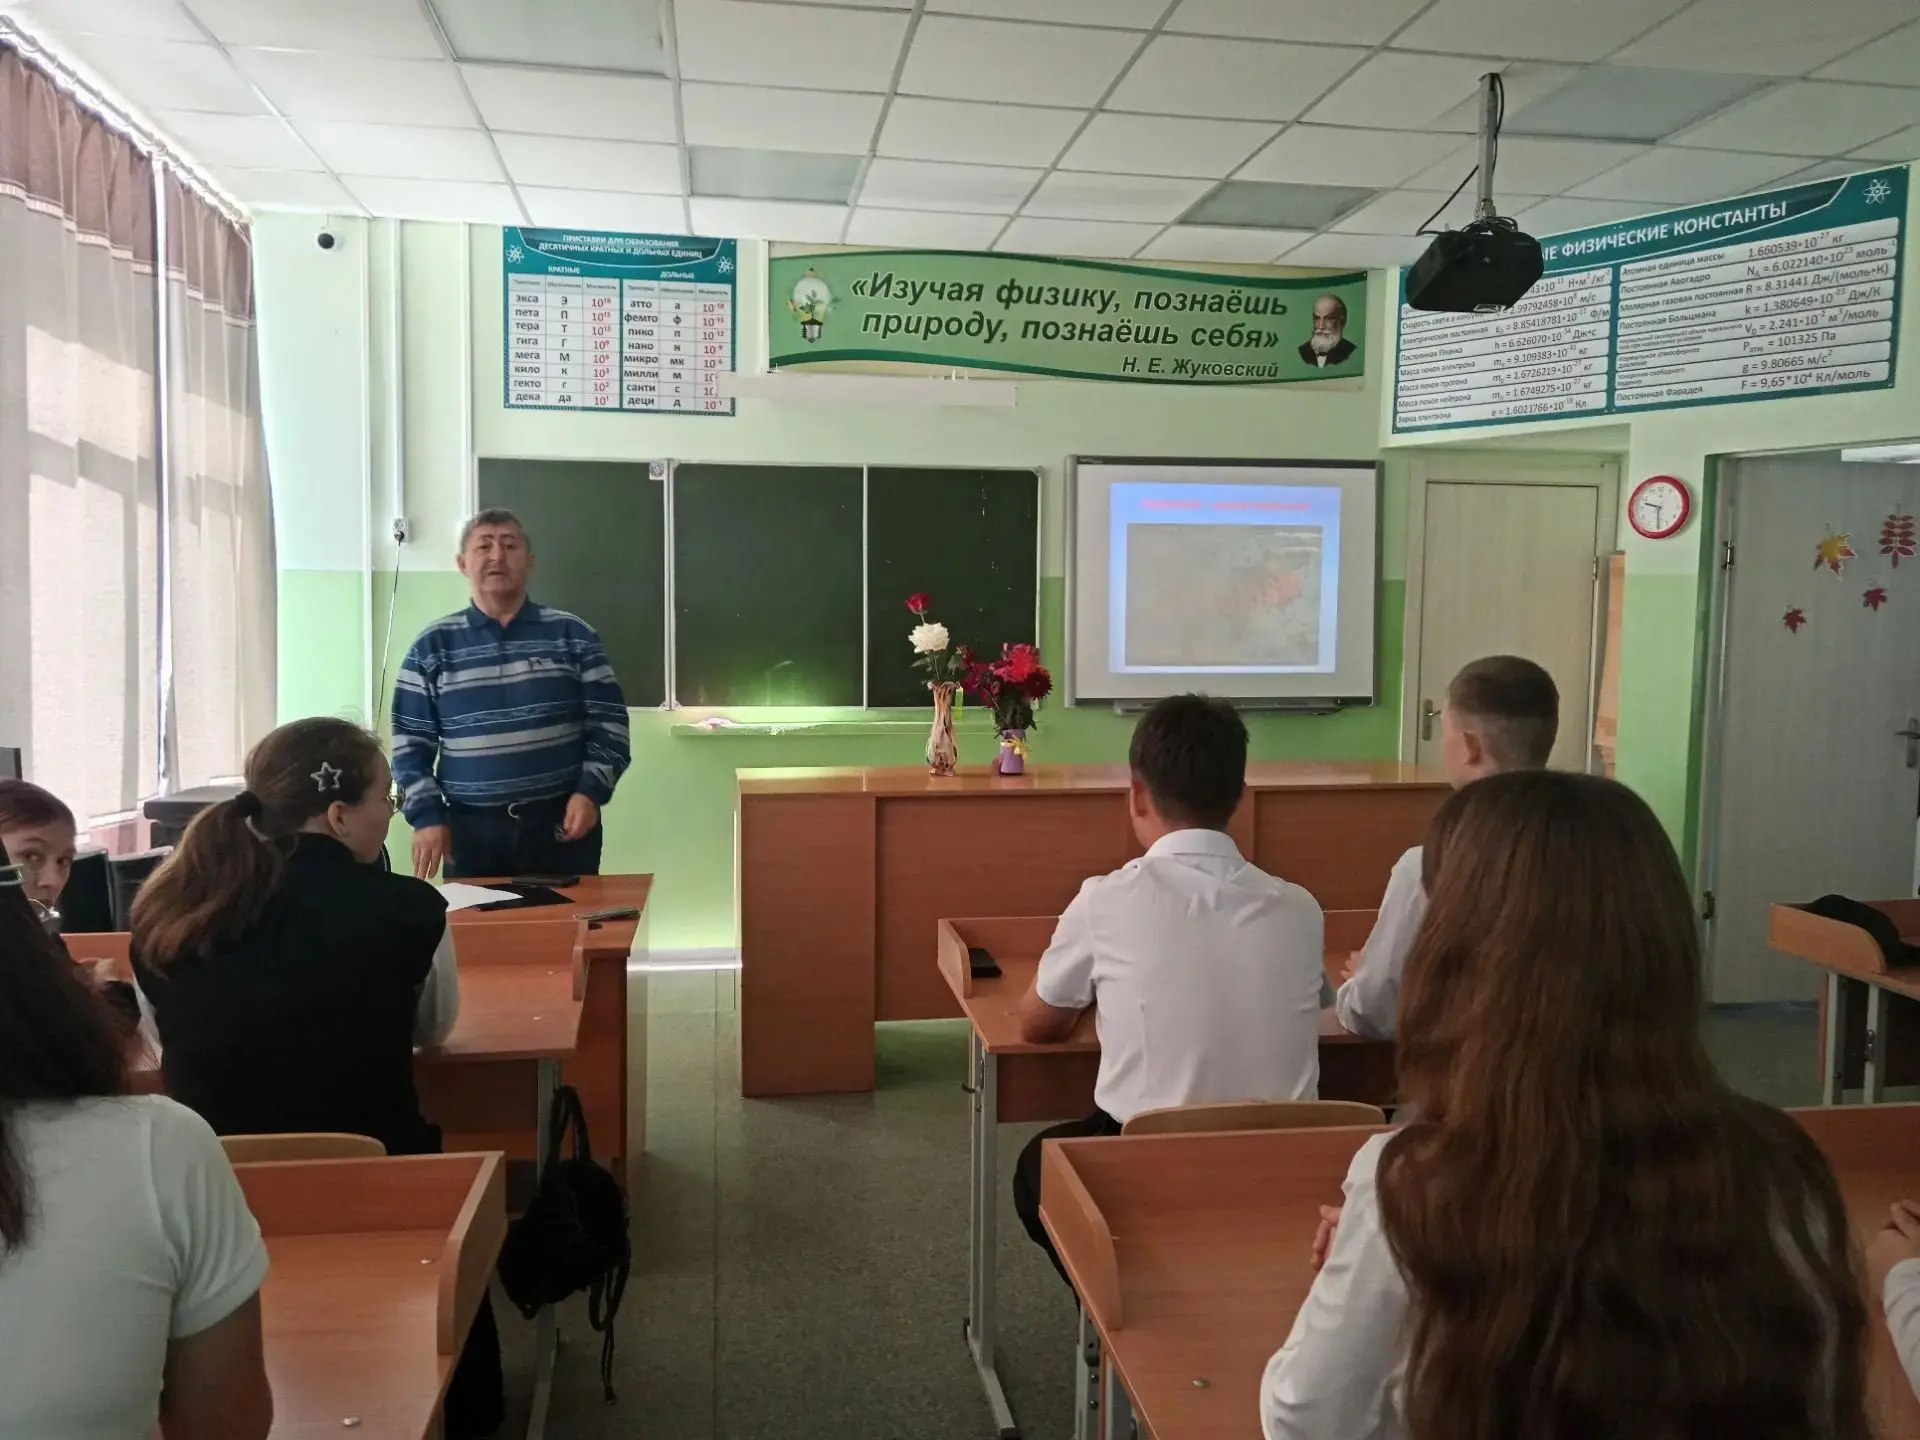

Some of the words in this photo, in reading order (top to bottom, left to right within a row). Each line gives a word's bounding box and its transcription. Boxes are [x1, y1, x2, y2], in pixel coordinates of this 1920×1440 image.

[1562, 223, 1669, 261] ФИЗИЧЕСКИЕ
[1674, 205, 1787, 237] КОНСТАНТЫ
[563, 235, 607, 243] ПРИСТАВКИ
[608, 237, 624, 245] ДЛЯ
[625, 238, 679, 248] ОБРАЗОВАНИЯ
[539, 243, 590, 252] ДЕСЯТИЧНЫХ
[590, 245, 624, 254] КРАТНЫХ
[633, 248, 670, 256] ДОЛЬНЫХ
[671, 250, 702, 258] ЕДИНИЦ
[1623, 263, 1657, 276] Атомная
[1659, 258, 1695, 271] единица
[1697, 252, 1725, 263] массы
[1832, 234, 1844, 244] кг
[548, 266, 581, 274] КРАТНЫЕ
[660, 271, 695, 279] ДОЛЬНЫЕ
[1621, 280, 1669, 294] Постоянная
[1670, 273, 1711, 286] Авогадро
[852, 272, 984, 305] «Изучая
[996, 278, 1120, 314] физику,
[1134, 289, 1288, 316] познаёшь
[1580, 293, 1597, 303] м/с
[1621, 299, 1661, 312] Молярная
[1662, 295, 1693, 306] газовая
[1694, 288, 1744, 301] постоянная
[1746, 284, 1753, 294] R
[1765, 275, 1808, 292] 8.31441
[516, 295, 539, 303] экса
[630, 300, 652, 309] атто
[1620, 317, 1667, 330] Постоянная
[1668, 310, 1717, 323] Больцмана
[1848, 286, 1881, 301] Дж/К
[515, 309, 539, 317] пета
[1590, 308, 1610, 320] Ф/м
[624, 313, 658, 323] фемто
[515, 322, 539, 331] тера
[862, 311, 1008, 344] природу,
[1021, 319, 1179, 345] познаёшь
[1191, 322, 1279, 349] себя»
[628, 328, 654, 337] пико
[516, 337, 538, 345] гига
[1777, 332, 1818, 347] 101325
[1821, 331, 1837, 342] Па
[628, 342, 654, 350] нано
[515, 352, 540, 360] мега
[624, 356, 658, 365] микро
[1122, 357, 1141, 373] Н.
[1148, 357, 1165, 374] Е.
[1172, 358, 1279, 378] Жуковский
[1743, 364, 1749, 374] g
[1761, 355, 1805, 370] 9.80665
[514, 366, 540, 374] кило
[624, 370, 659, 378] милли
[1400, 368, 1420, 376] Масса
[1400, 384, 1419, 392] Масса
[1584, 364, 1593, 372] кг
[514, 380, 541, 388] гекто
[626, 384, 656, 392] санти
[1584, 382, 1593, 390] кг
[1616, 387, 1664, 401] Постоянная
[1816, 370, 1871, 384] Кл/моль
[515, 393, 540, 402] дека
[628, 397, 655, 406] деци
[1575, 400, 1587, 408] Кл
